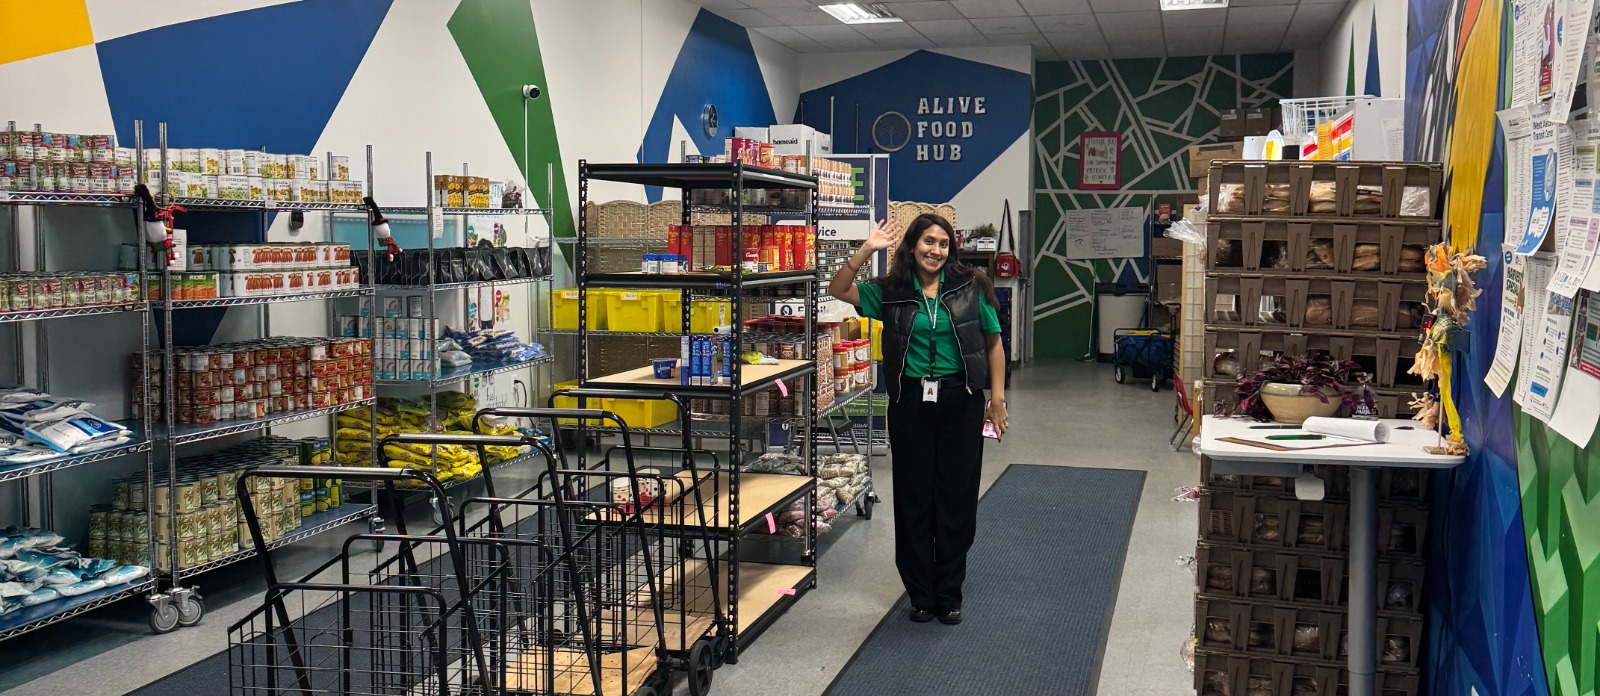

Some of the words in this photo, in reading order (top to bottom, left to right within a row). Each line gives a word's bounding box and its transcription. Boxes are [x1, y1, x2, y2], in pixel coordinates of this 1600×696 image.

[917, 96, 986, 115] ALIVE
[917, 121, 974, 139] FOOD
[916, 144, 962, 161] HUB
